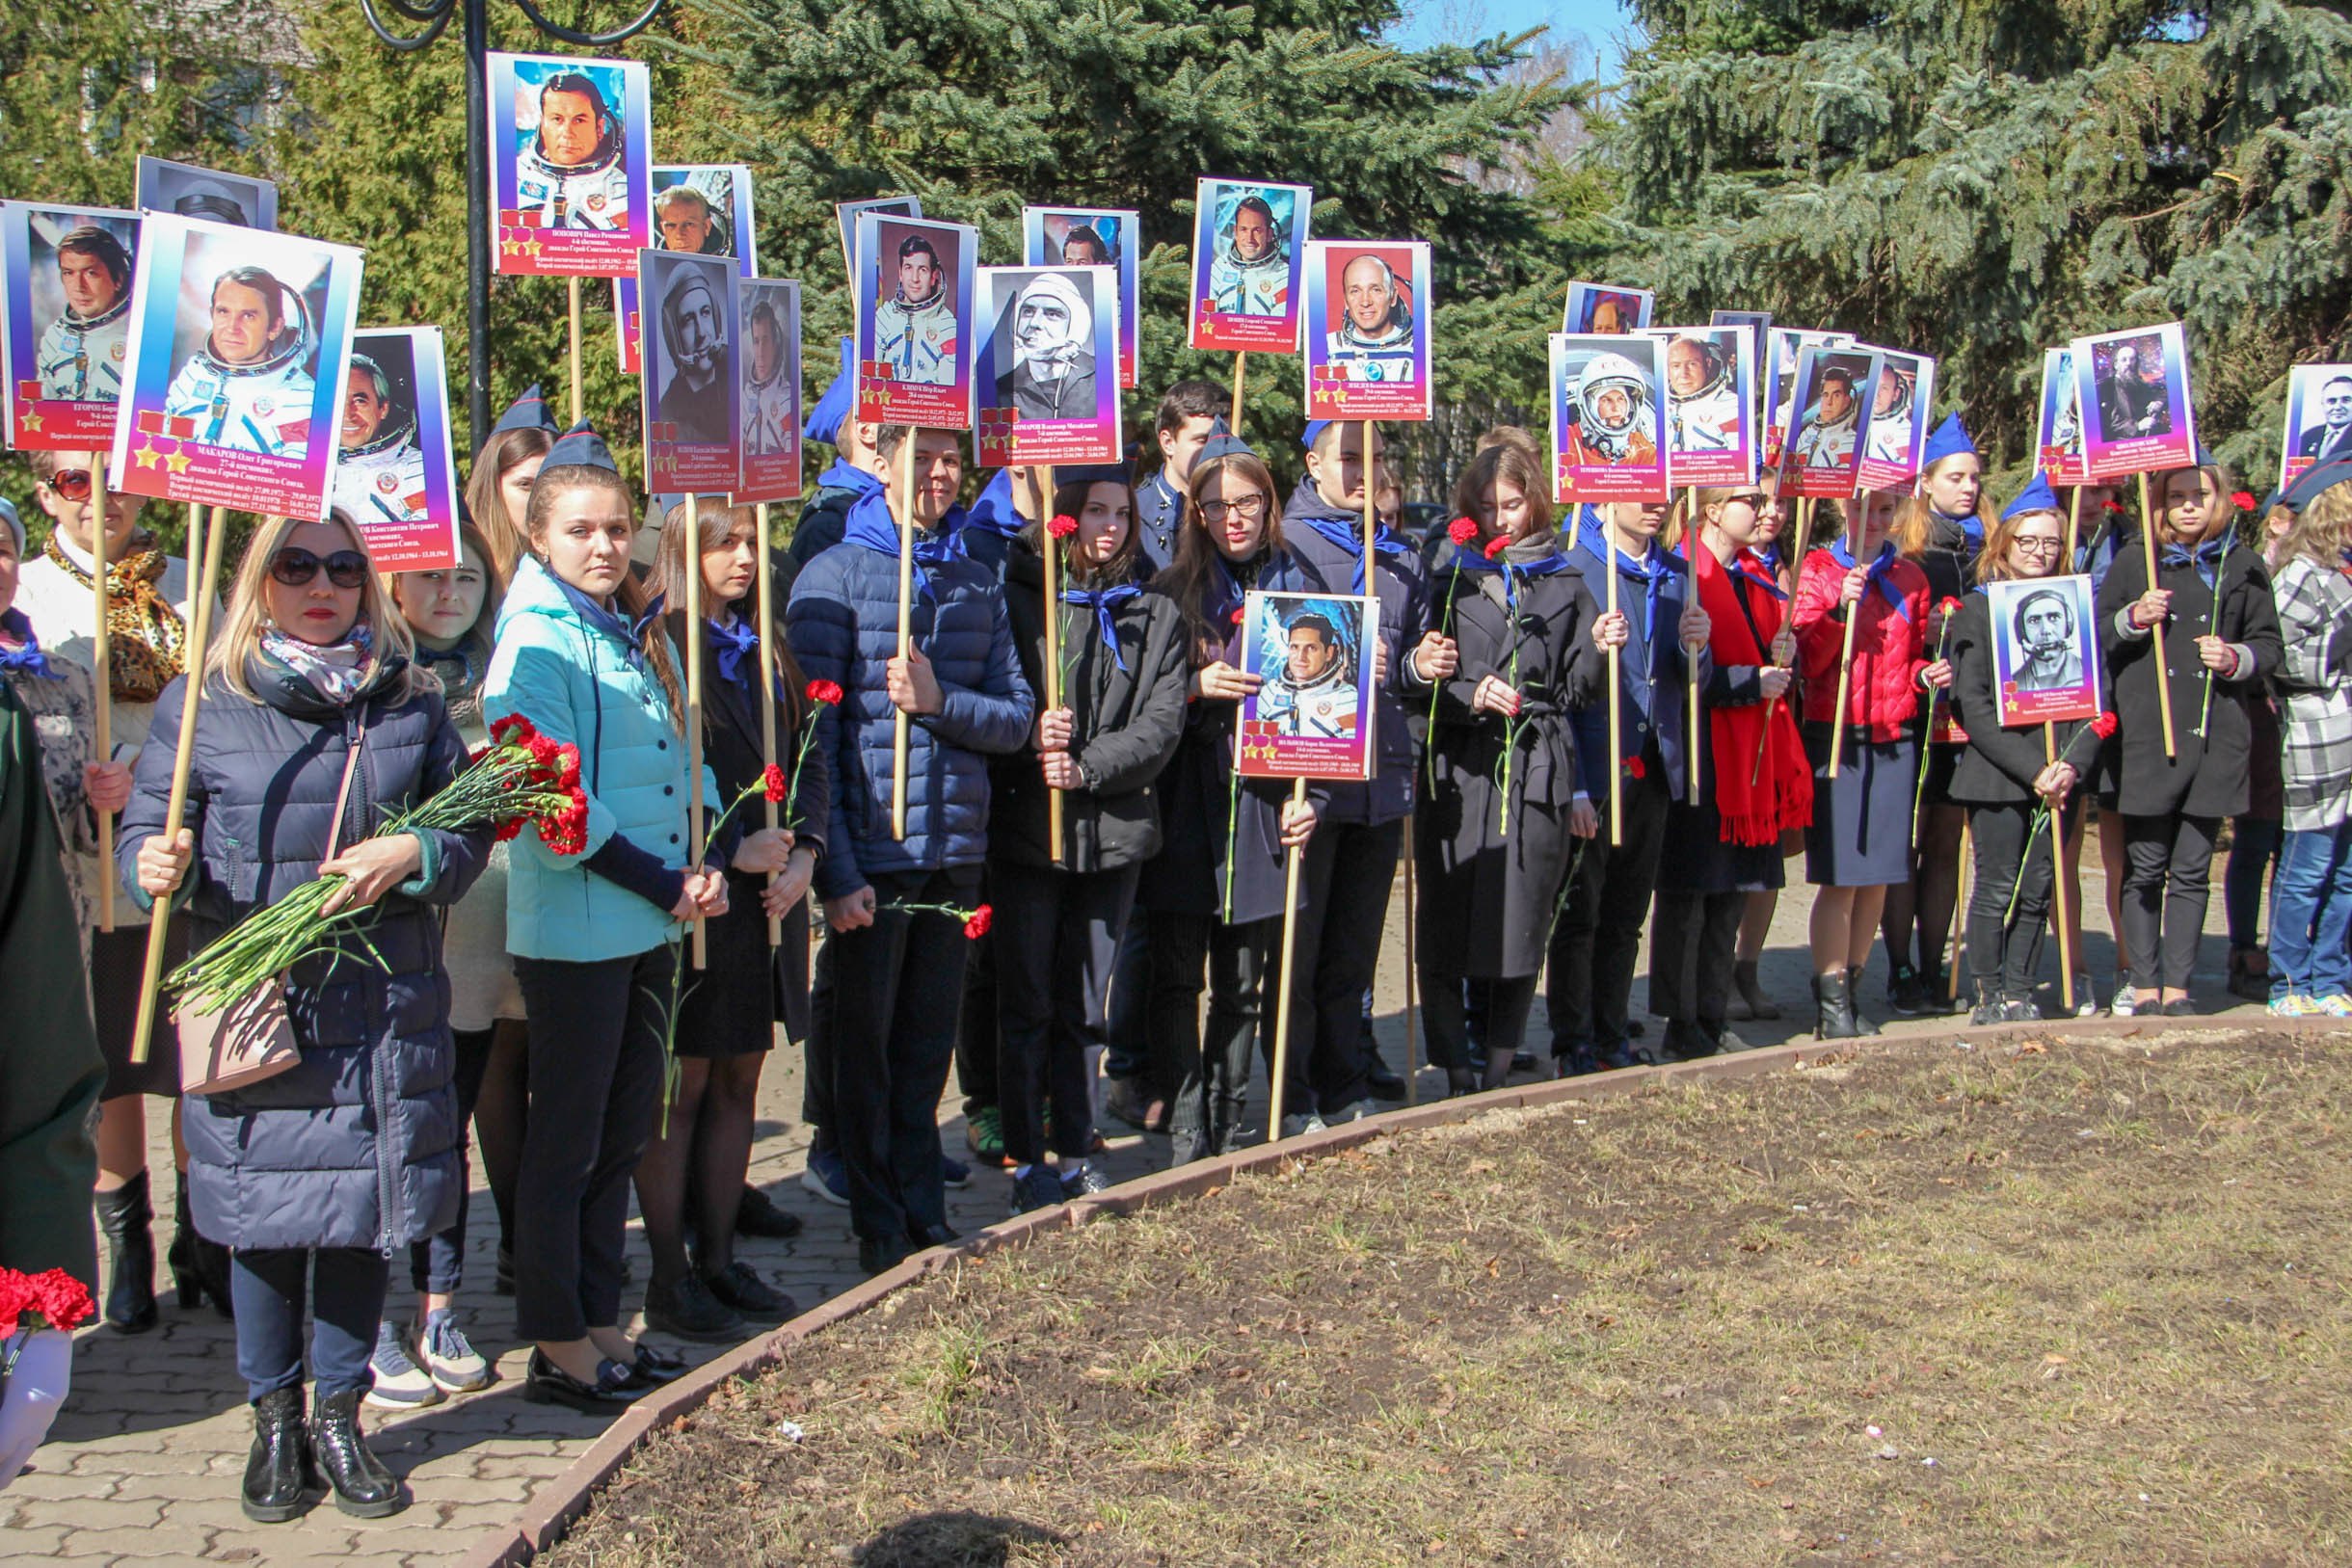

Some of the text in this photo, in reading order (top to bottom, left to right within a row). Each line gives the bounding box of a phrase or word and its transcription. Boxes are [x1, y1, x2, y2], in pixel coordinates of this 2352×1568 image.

[198, 446, 302, 471] МАКАРОВ Олег Григорьевич
[220, 460, 235, 468] 27-й
[169, 473, 194, 484] Первый
[196, 477, 234, 490] космический
[190, 465, 306, 489] дважды Герой Советского Союза.
[170, 482, 192, 492] Второй
[193, 486, 232, 497] космический
[371, 523, 408, 534] Константин
[409, 520, 439, 532] Петрович
